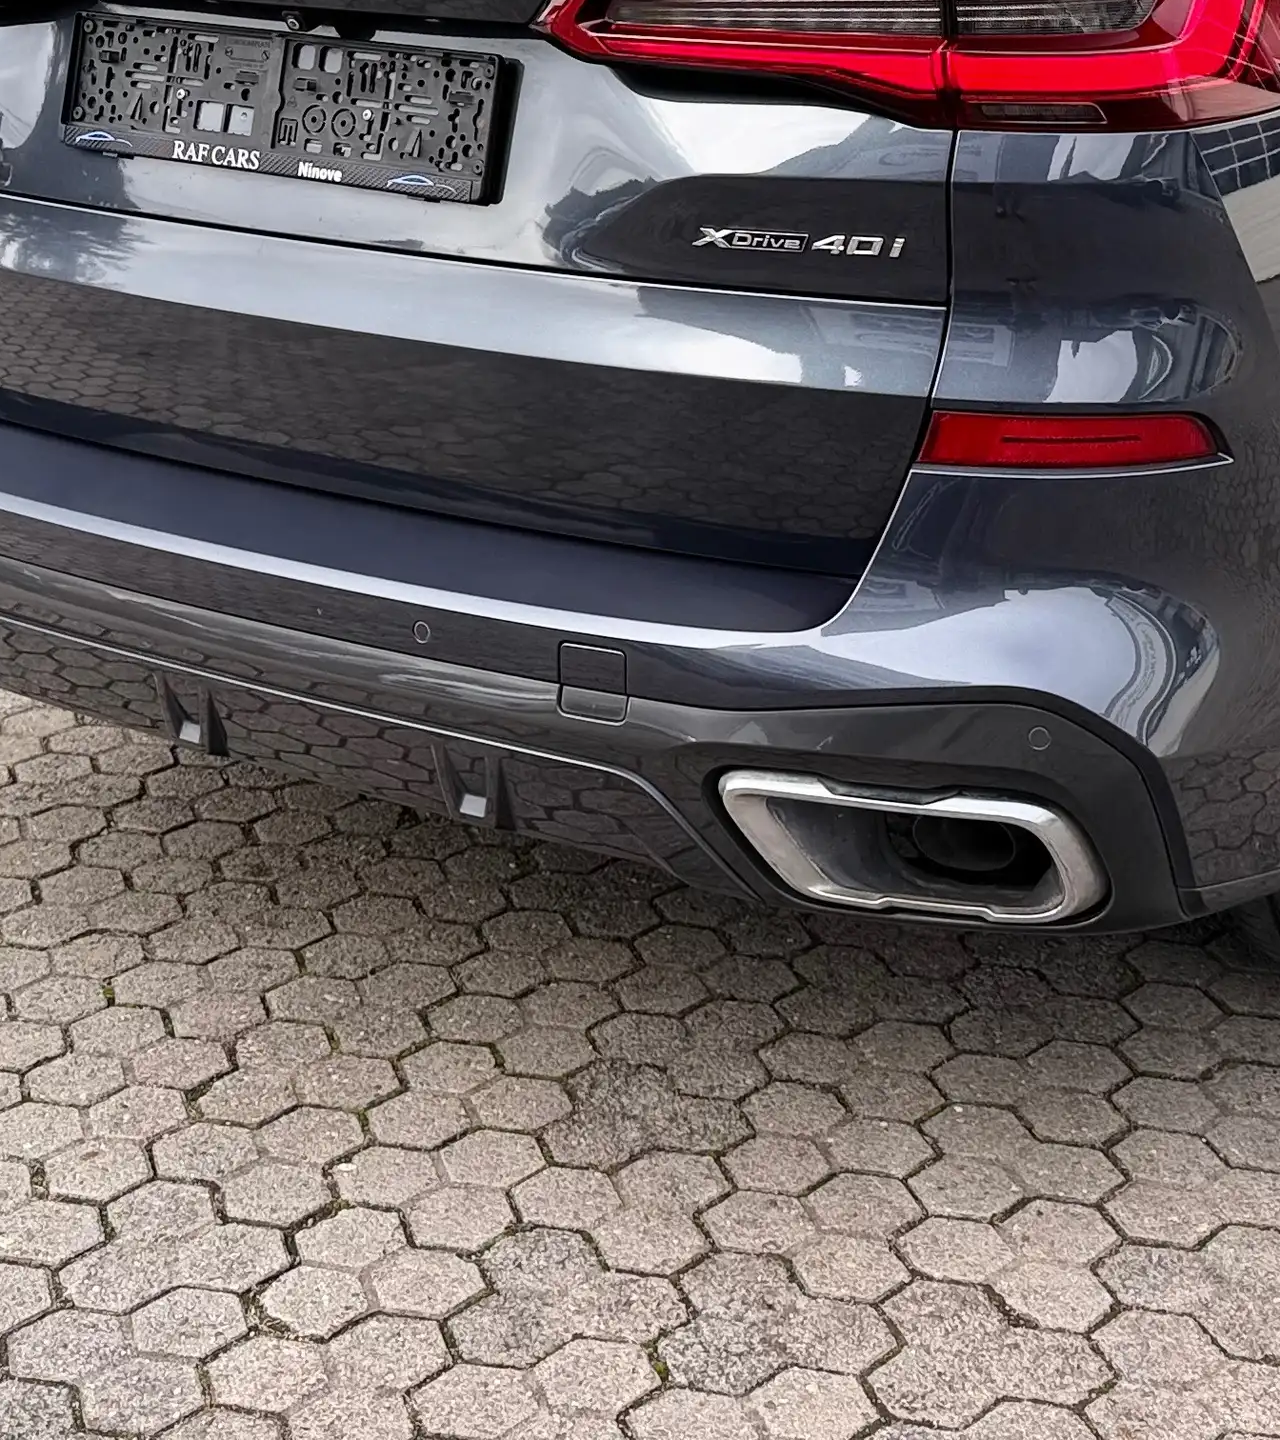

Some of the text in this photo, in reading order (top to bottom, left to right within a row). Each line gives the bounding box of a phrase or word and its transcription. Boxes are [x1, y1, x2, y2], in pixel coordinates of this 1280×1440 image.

[171, 140, 261, 171] RAF CARS
[297, 161, 344, 183] Ninove
